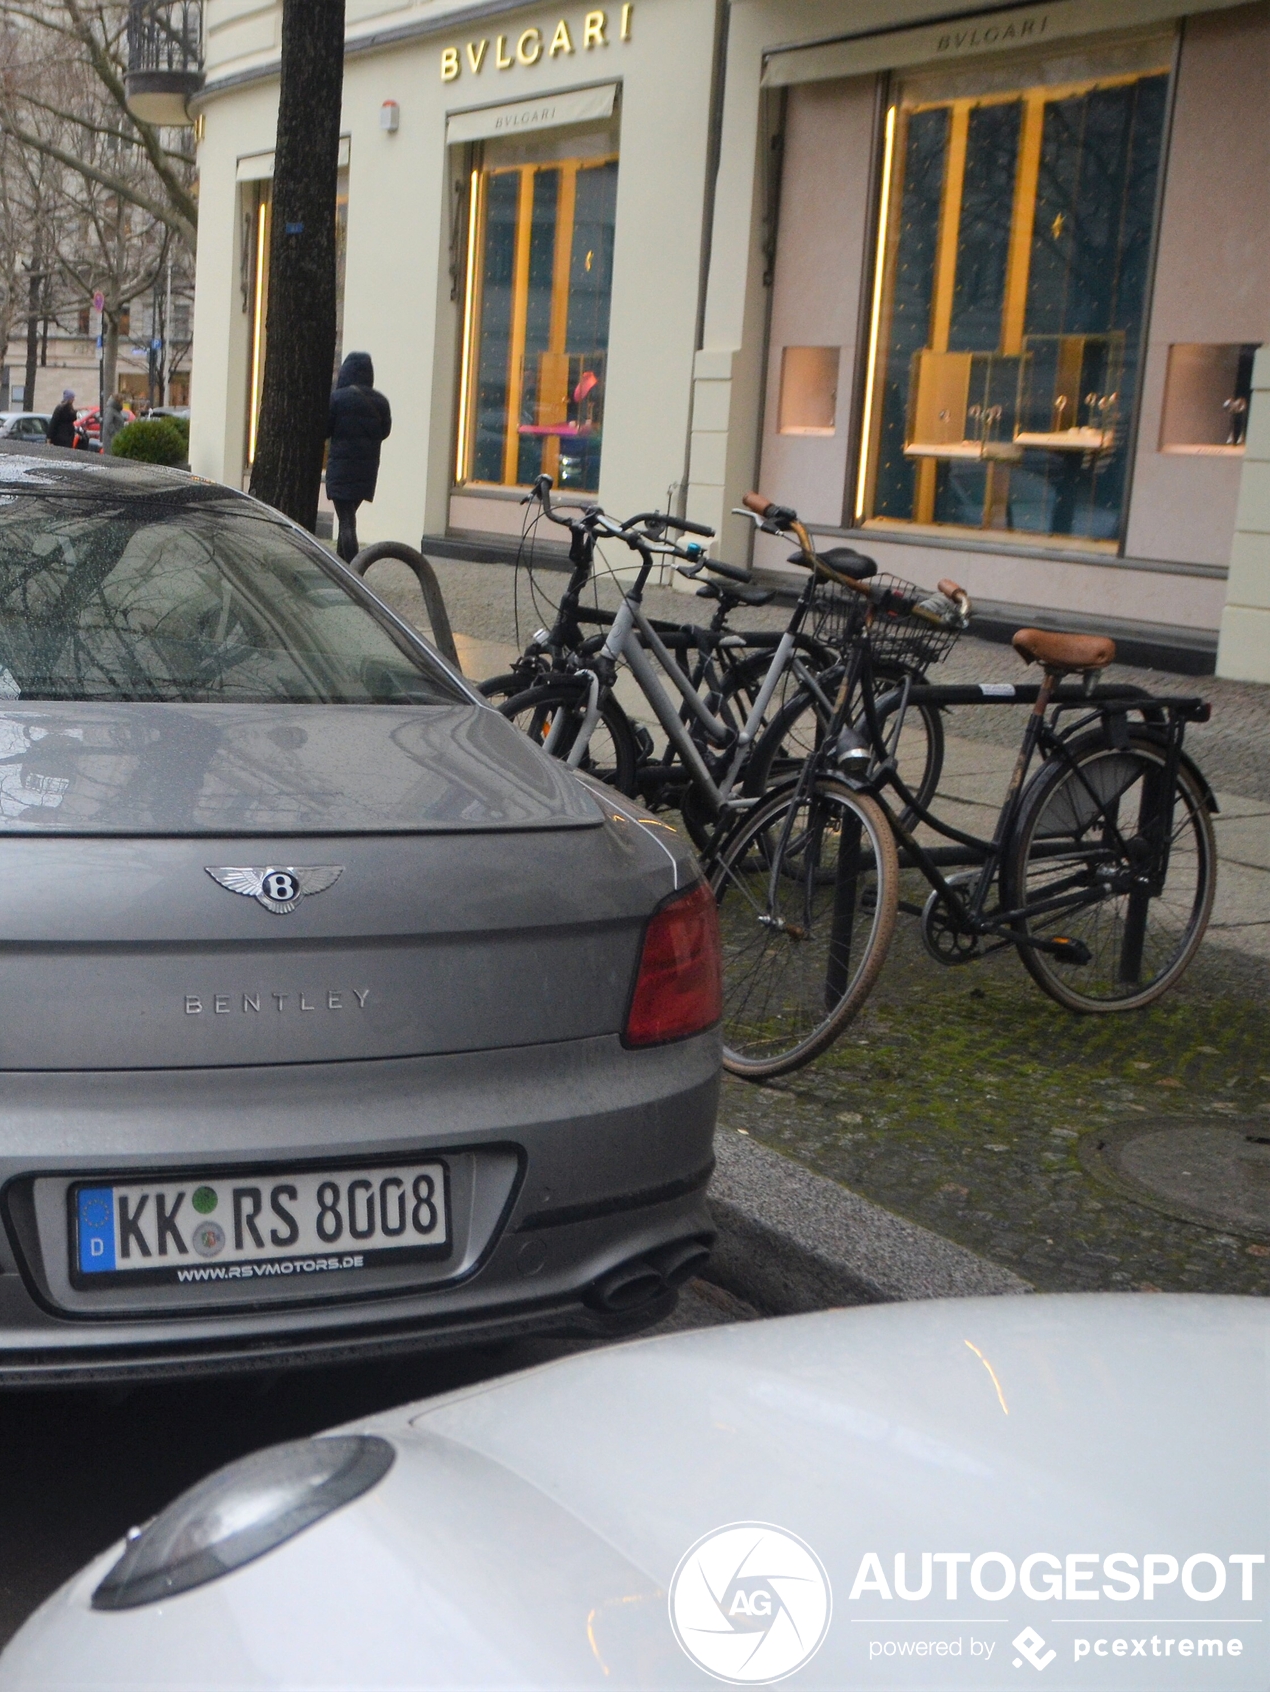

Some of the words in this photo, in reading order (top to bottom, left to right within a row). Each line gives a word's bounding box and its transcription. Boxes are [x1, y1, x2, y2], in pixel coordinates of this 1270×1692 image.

[440, 3, 632, 83] BVLGARI
[937, 16, 1048, 51] BVLGARI
[495, 107, 556, 129] BVLGARI
[185, 989, 370, 1014] BENTLEY
[118, 1192, 189, 1259] KK
[232, 1184, 299, 1250] RS
[316, 1174, 438, 1244] 8008
[91, 1238, 104, 1256] D
[177, 1255, 364, 1282] WWW.RSVMOTORS.DE
